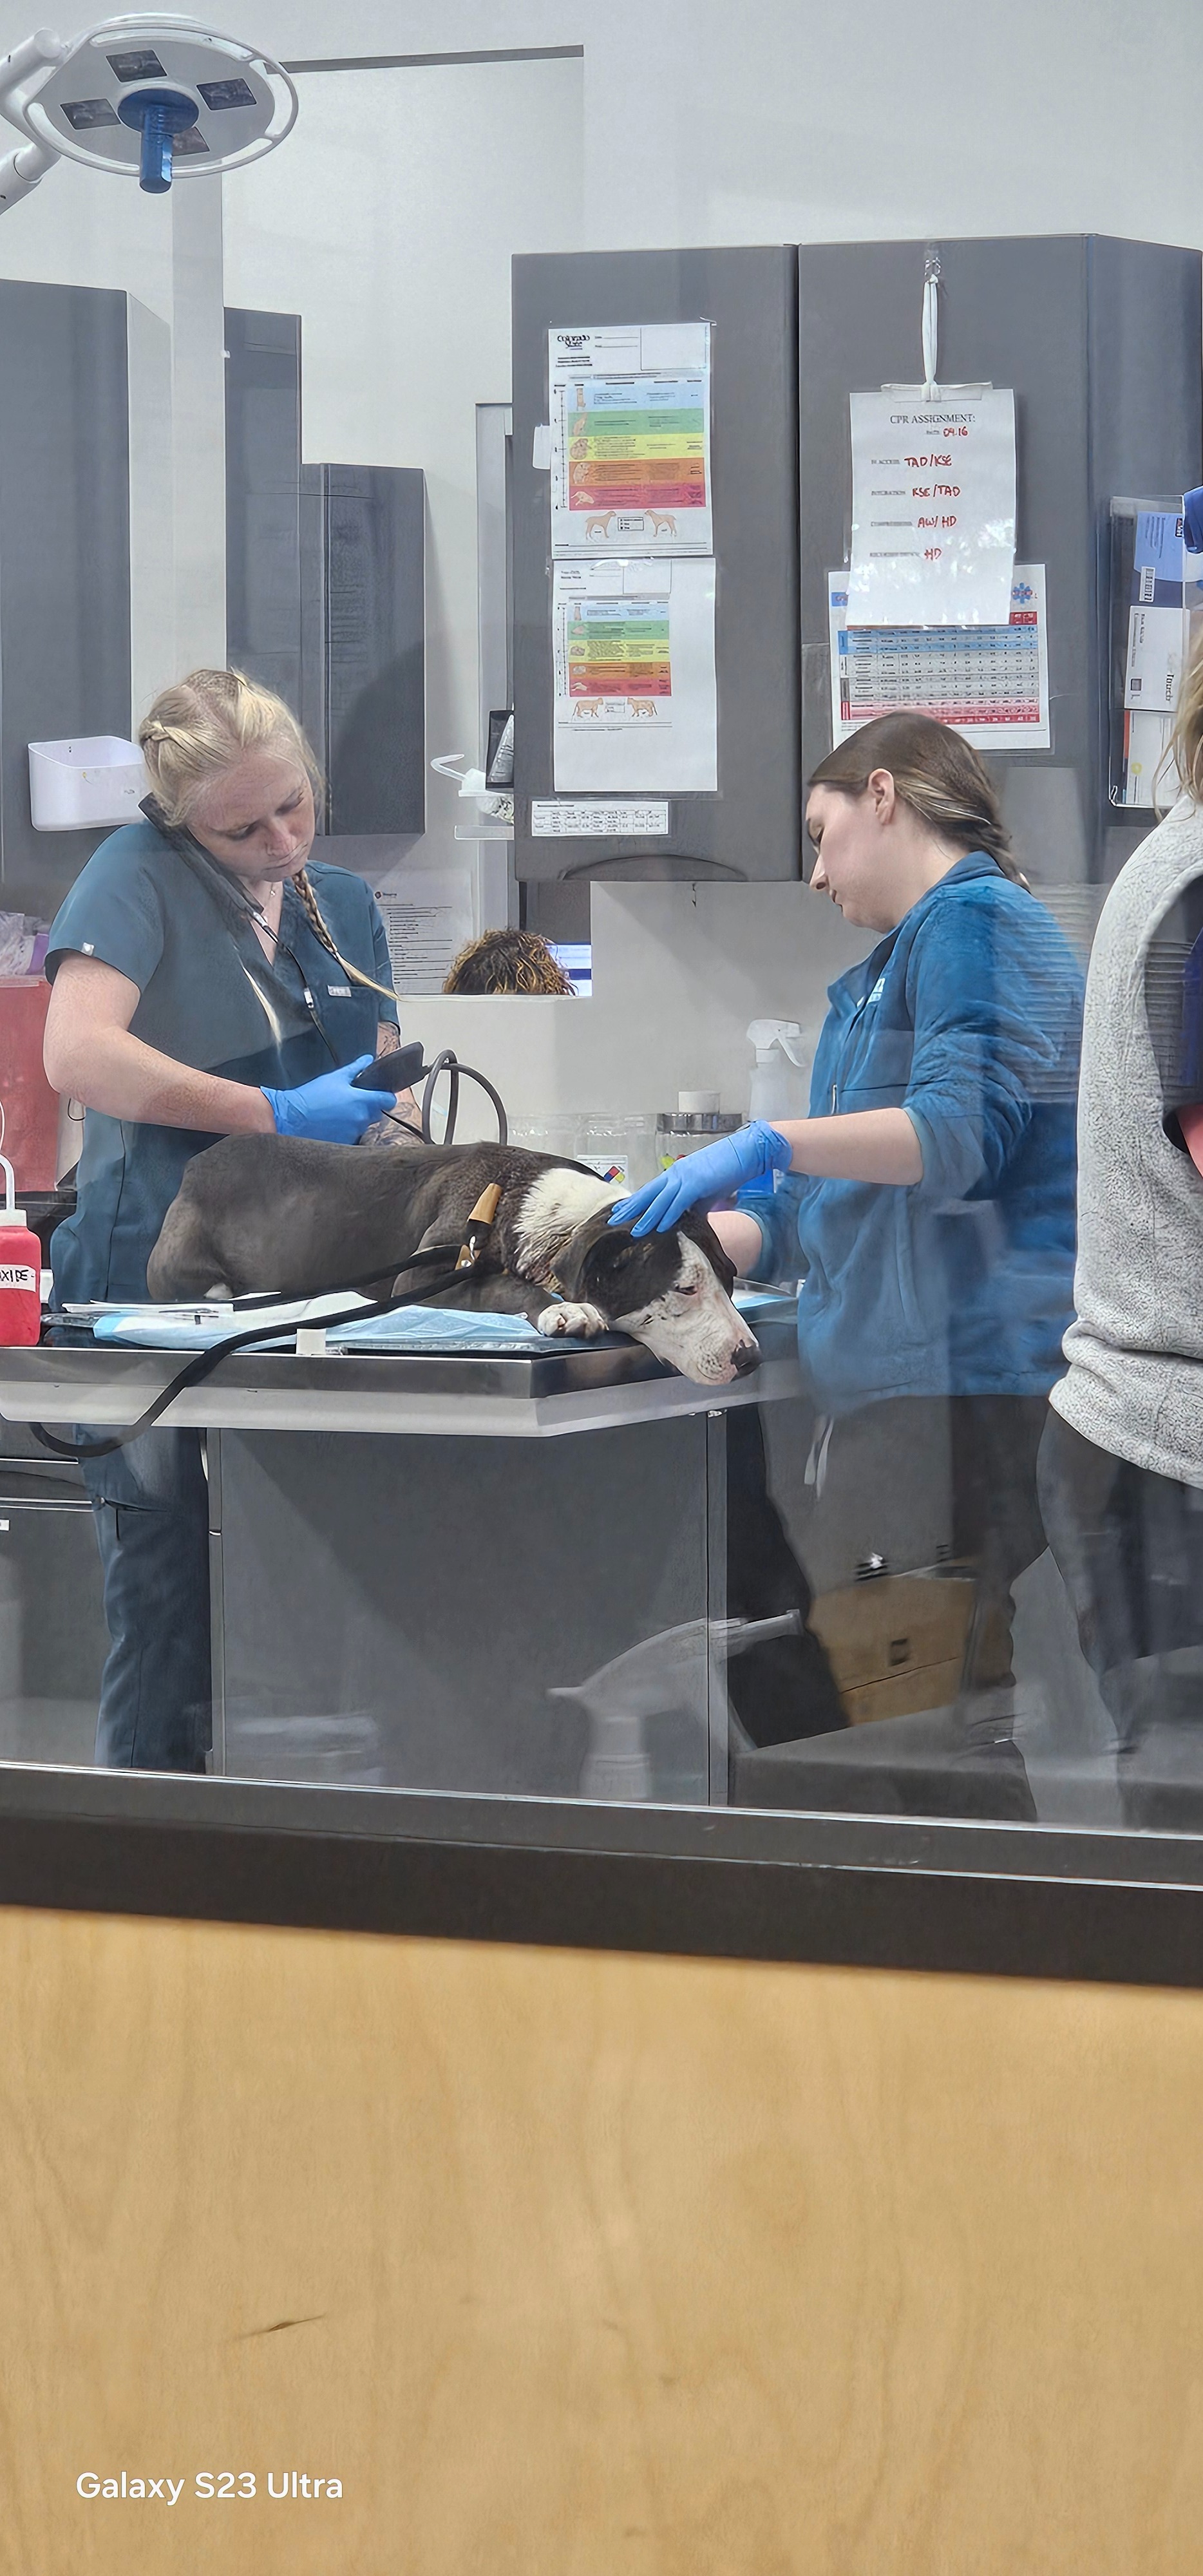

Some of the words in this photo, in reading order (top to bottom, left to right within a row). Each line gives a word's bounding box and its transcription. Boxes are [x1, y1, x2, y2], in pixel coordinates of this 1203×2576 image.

[890, 415, 909, 424] CPR
[911, 413, 976, 424] ASSIGNMENT:
[0, 1269, 29, 1282] XIDE
